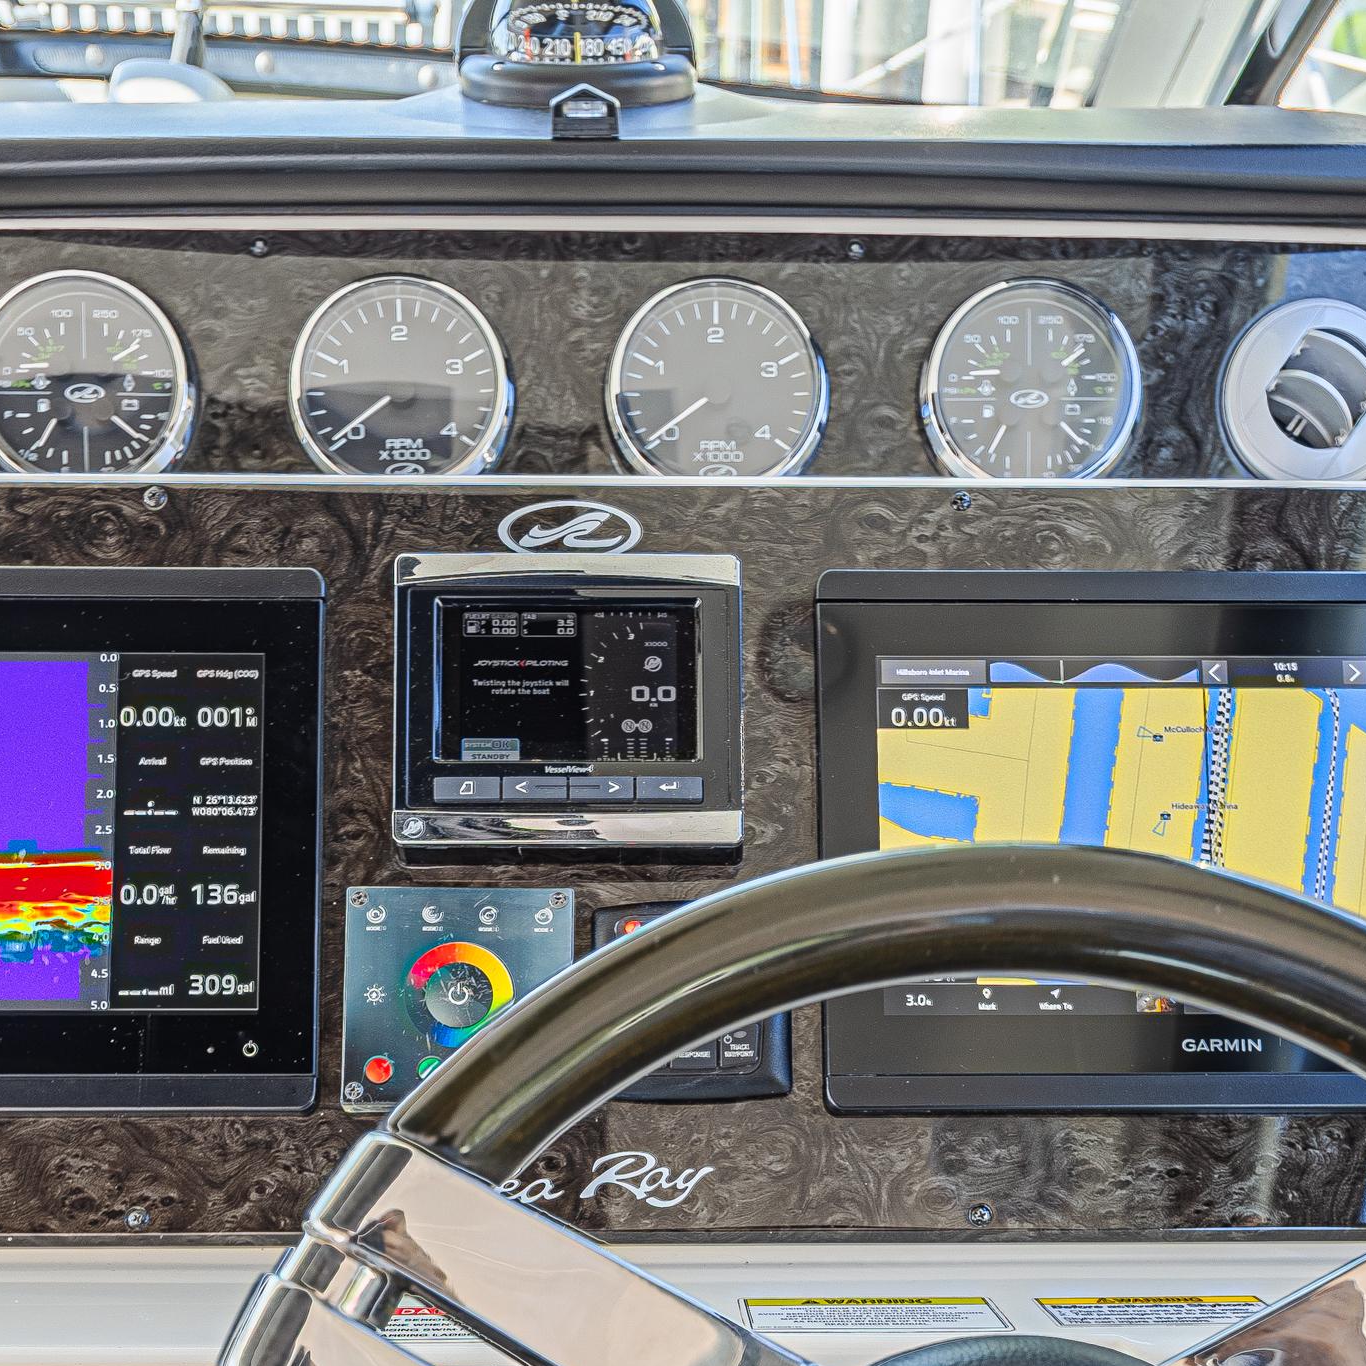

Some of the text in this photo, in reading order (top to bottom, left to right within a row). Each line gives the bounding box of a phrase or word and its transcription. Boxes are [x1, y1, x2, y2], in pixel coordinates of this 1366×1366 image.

[390, 326, 408, 341] 2
[706, 327, 724, 343] 2
[446, 360, 463, 375] 3
[760, 362, 778, 377] 3
[438, 423, 457, 437] 4
[754, 425, 772, 439] 4
[385, 438, 422, 449] RPM
[379, 449, 431, 460] X1000
[631, 686, 676, 701] 0.0
[978, 1002, 997, 1010] Mark
[1182, 1039, 1262, 1052] GARMIN
[580, 1151, 715, 1208] Ray
